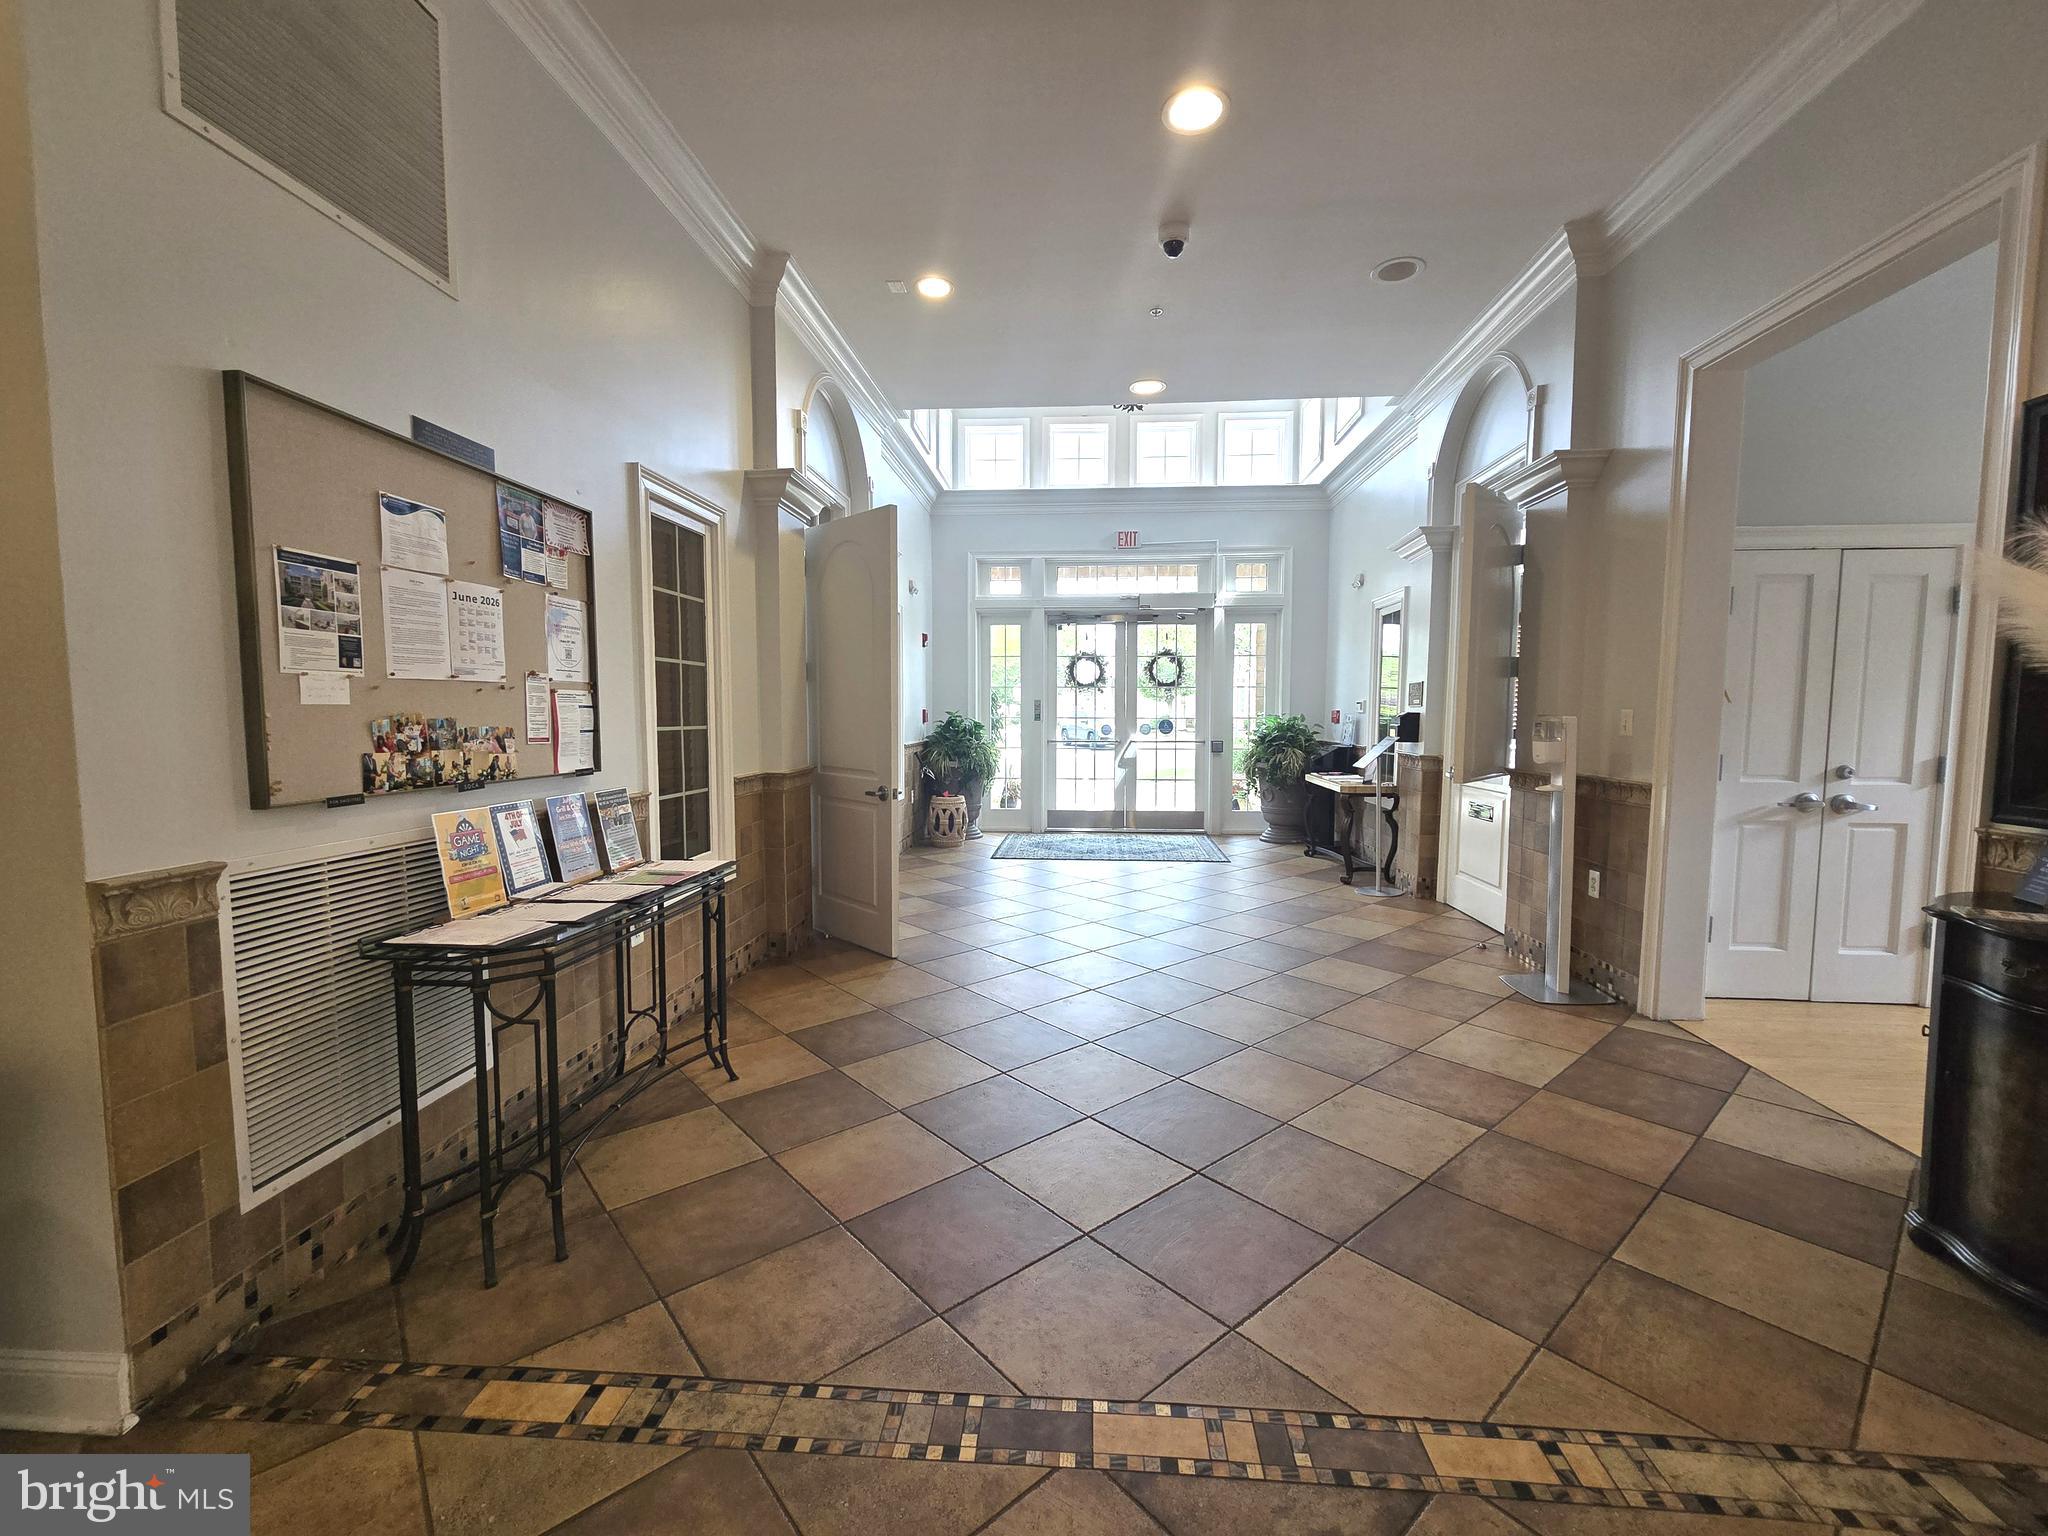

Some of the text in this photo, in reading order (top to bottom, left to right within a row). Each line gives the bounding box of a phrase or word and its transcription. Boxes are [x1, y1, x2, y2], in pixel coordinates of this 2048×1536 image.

[1118, 531, 1138, 547] EXIT
[452, 591, 500, 608] June 2026
[510, 819, 522, 828] JULY
[453, 832, 481, 847] GAME
[459, 844, 480, 858] NIGHT
